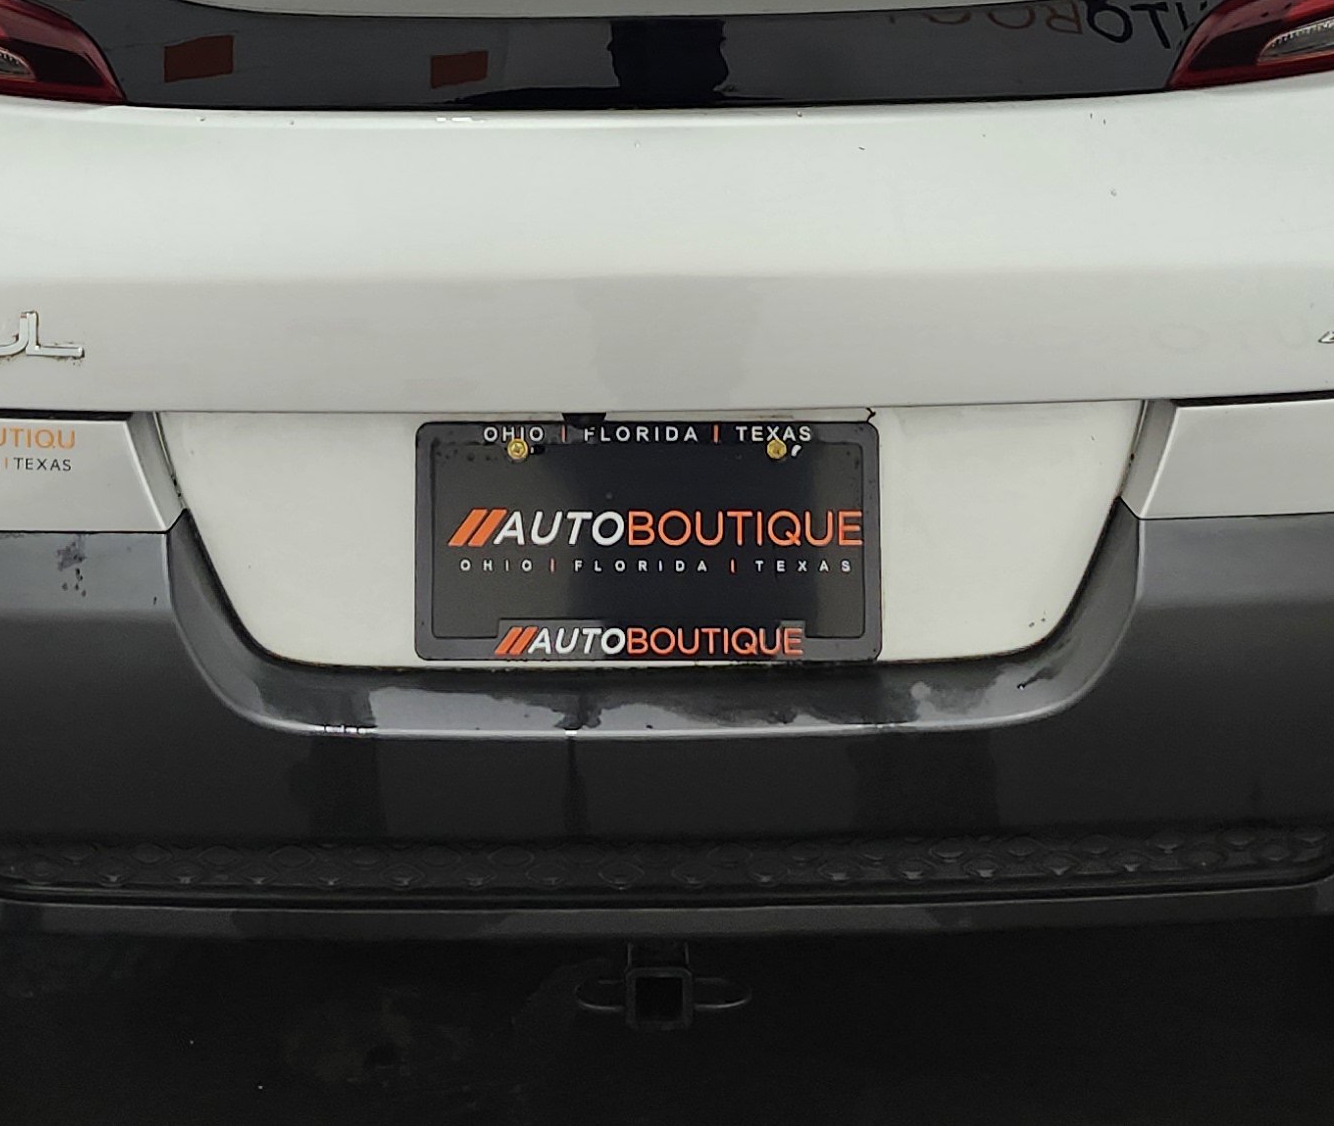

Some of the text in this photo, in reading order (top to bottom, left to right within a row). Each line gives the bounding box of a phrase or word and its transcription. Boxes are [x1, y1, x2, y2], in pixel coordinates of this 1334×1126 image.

[483, 425, 811, 442] OHIO FLORIDA TEXAS
[13, 456, 72, 472] TEXAS
[460, 559, 851, 573] OHIO FLORIDA TEXAS
